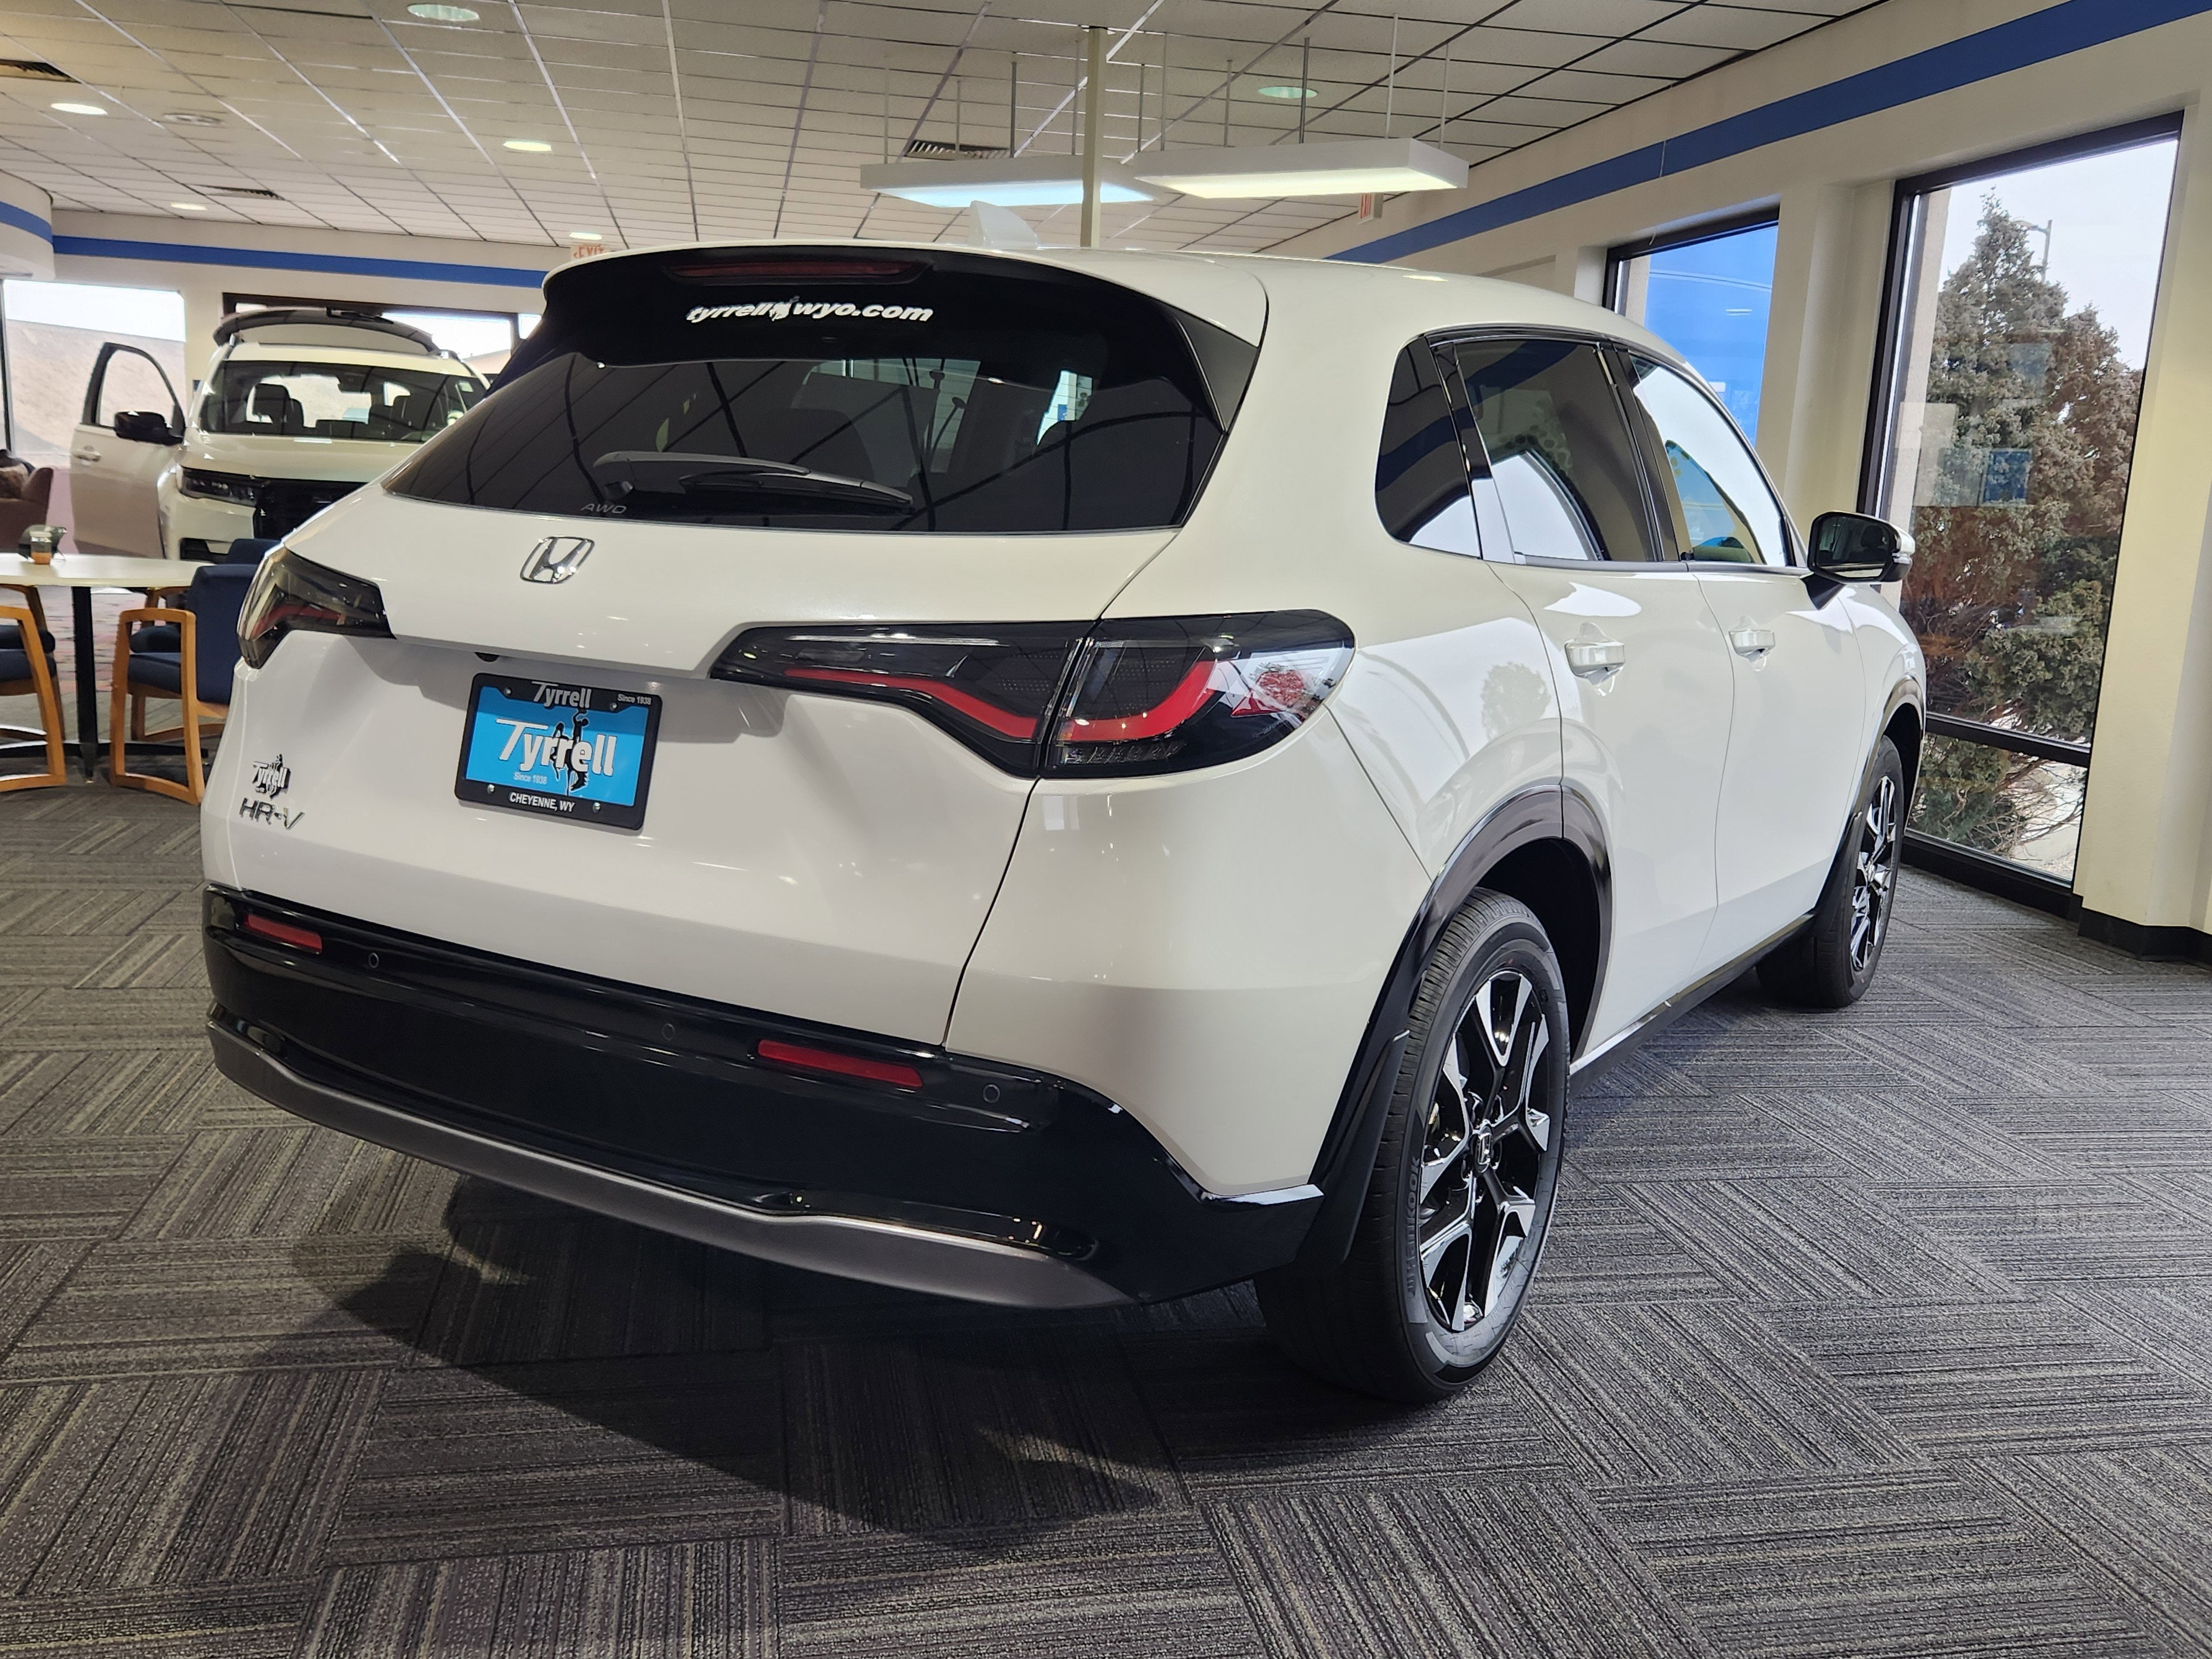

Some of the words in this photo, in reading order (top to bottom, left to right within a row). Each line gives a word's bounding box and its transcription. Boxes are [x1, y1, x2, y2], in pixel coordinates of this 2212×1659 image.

[581, 503, 627, 514] AWD
[531, 681, 592, 708] Tyrrell
[617, 693, 636, 703] Since
[496, 718, 617, 776] Tyrrell
[513, 772, 531, 782] Since
[509, 792, 558, 812] CHEYENNE,
[560, 800, 575, 812] WY
[239, 797, 305, 830] HR-V
